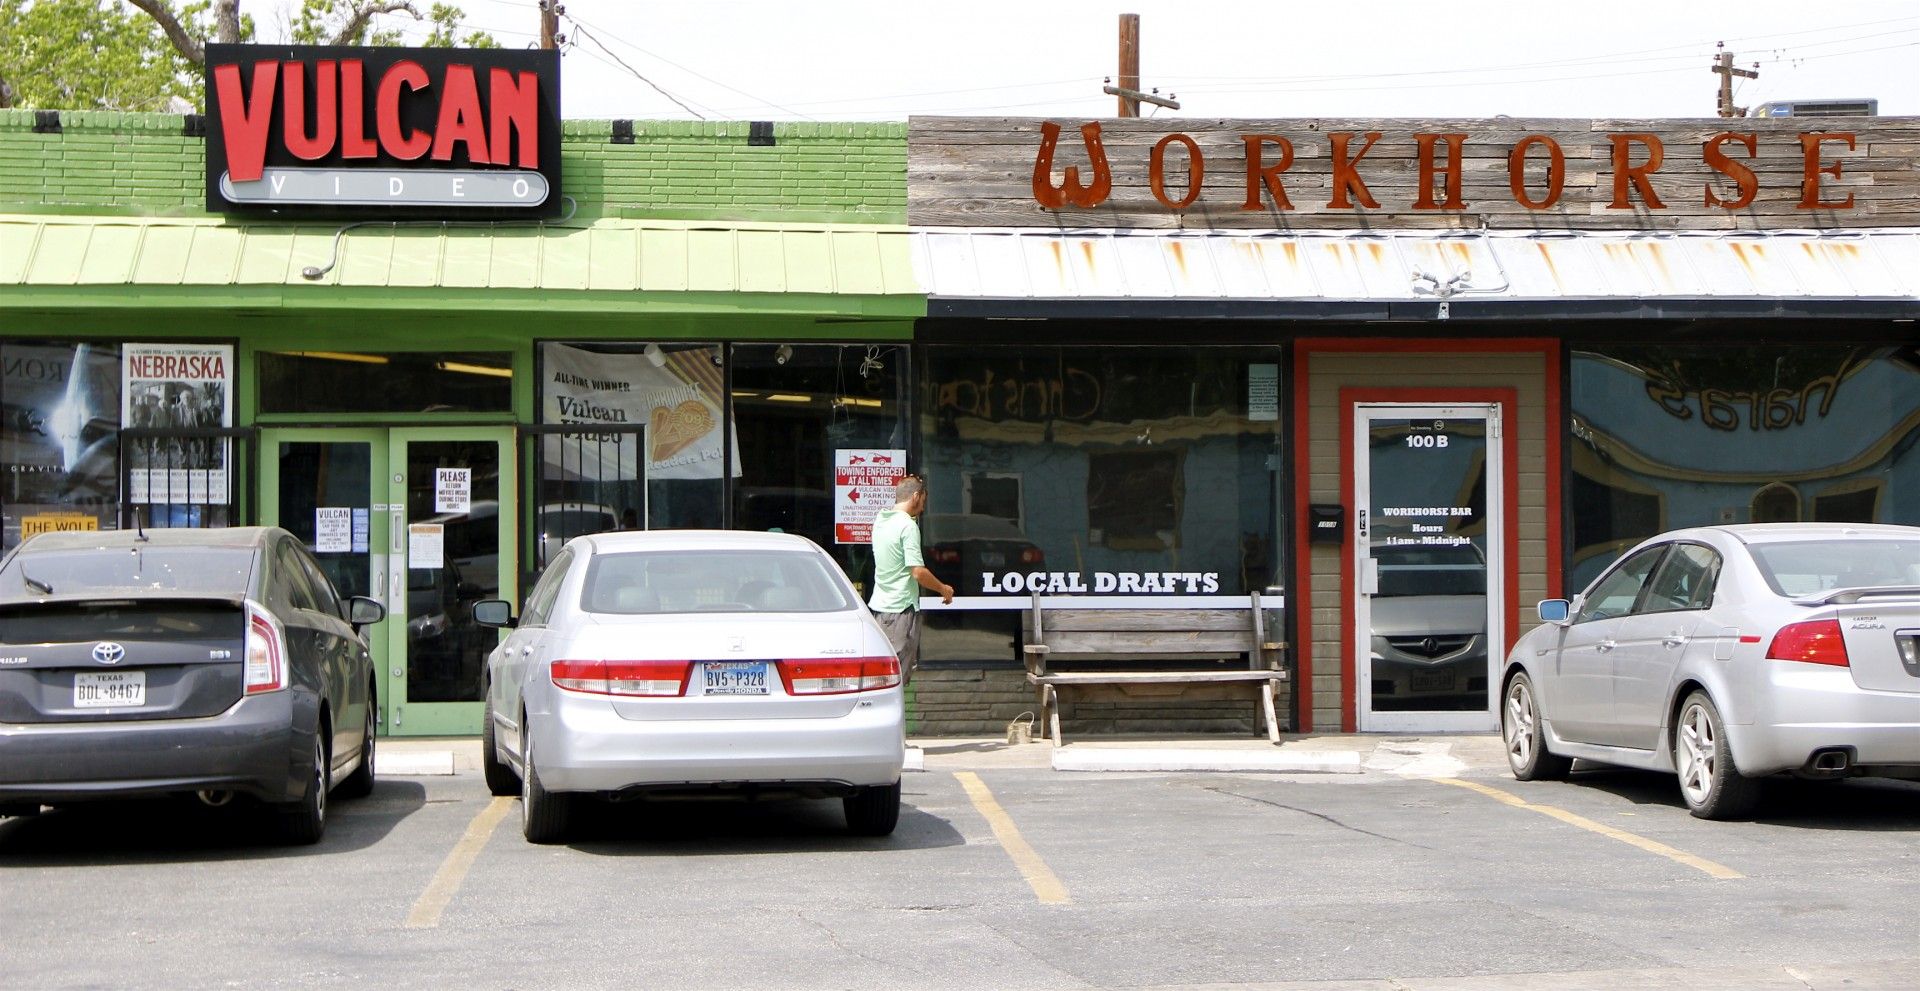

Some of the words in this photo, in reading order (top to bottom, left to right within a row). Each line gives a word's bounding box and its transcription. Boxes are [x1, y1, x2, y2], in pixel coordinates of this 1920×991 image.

[214, 58, 538, 183] VULCAN
[1032, 121, 1857, 211] WORKHORSE
[271, 174, 530, 199] VIDEO
[130, 355, 225, 379] NEBRASKA
[554, 371, 590, 389] ALL-TIME
[592, 379, 631, 393] WINNER
[556, 395, 627, 423] Vulcan
[1405, 434, 1435, 448] 100
[1436, 434, 1449, 448] B
[10, 464, 66, 473] GRAVITY
[837, 467, 865, 477] TOWING
[866, 467, 904, 477] ENFORCED
[439, 471, 467, 482] PLEASE
[847, 476, 857, 485] AT
[857, 476, 871, 485] ALL
[871, 476, 893, 485] TIMES
[319, 510, 349, 519] VULCAN
[1383, 507, 1449, 516] WORKHORSE
[1450, 507, 1472, 516] BAR
[24, 520, 51, 533] THE
[55, 521, 95, 531] WOLF
[1412, 523, 1443, 532] Hours
[1386, 536, 1415, 545] 11am
[1422, 536, 1471, 547] Midnight
[982, 571, 1087, 593] LOCAL
[1094, 571, 1219, 593] DRAFTS
[721, 662, 749, 670] TEXAS
[97, 674, 124, 682] TEXAS
[707, 671, 728, 687] BV5
[736, 671, 765, 687] P328
[78, 685, 101, 700] BDL
[109, 683, 141, 699] 8467
